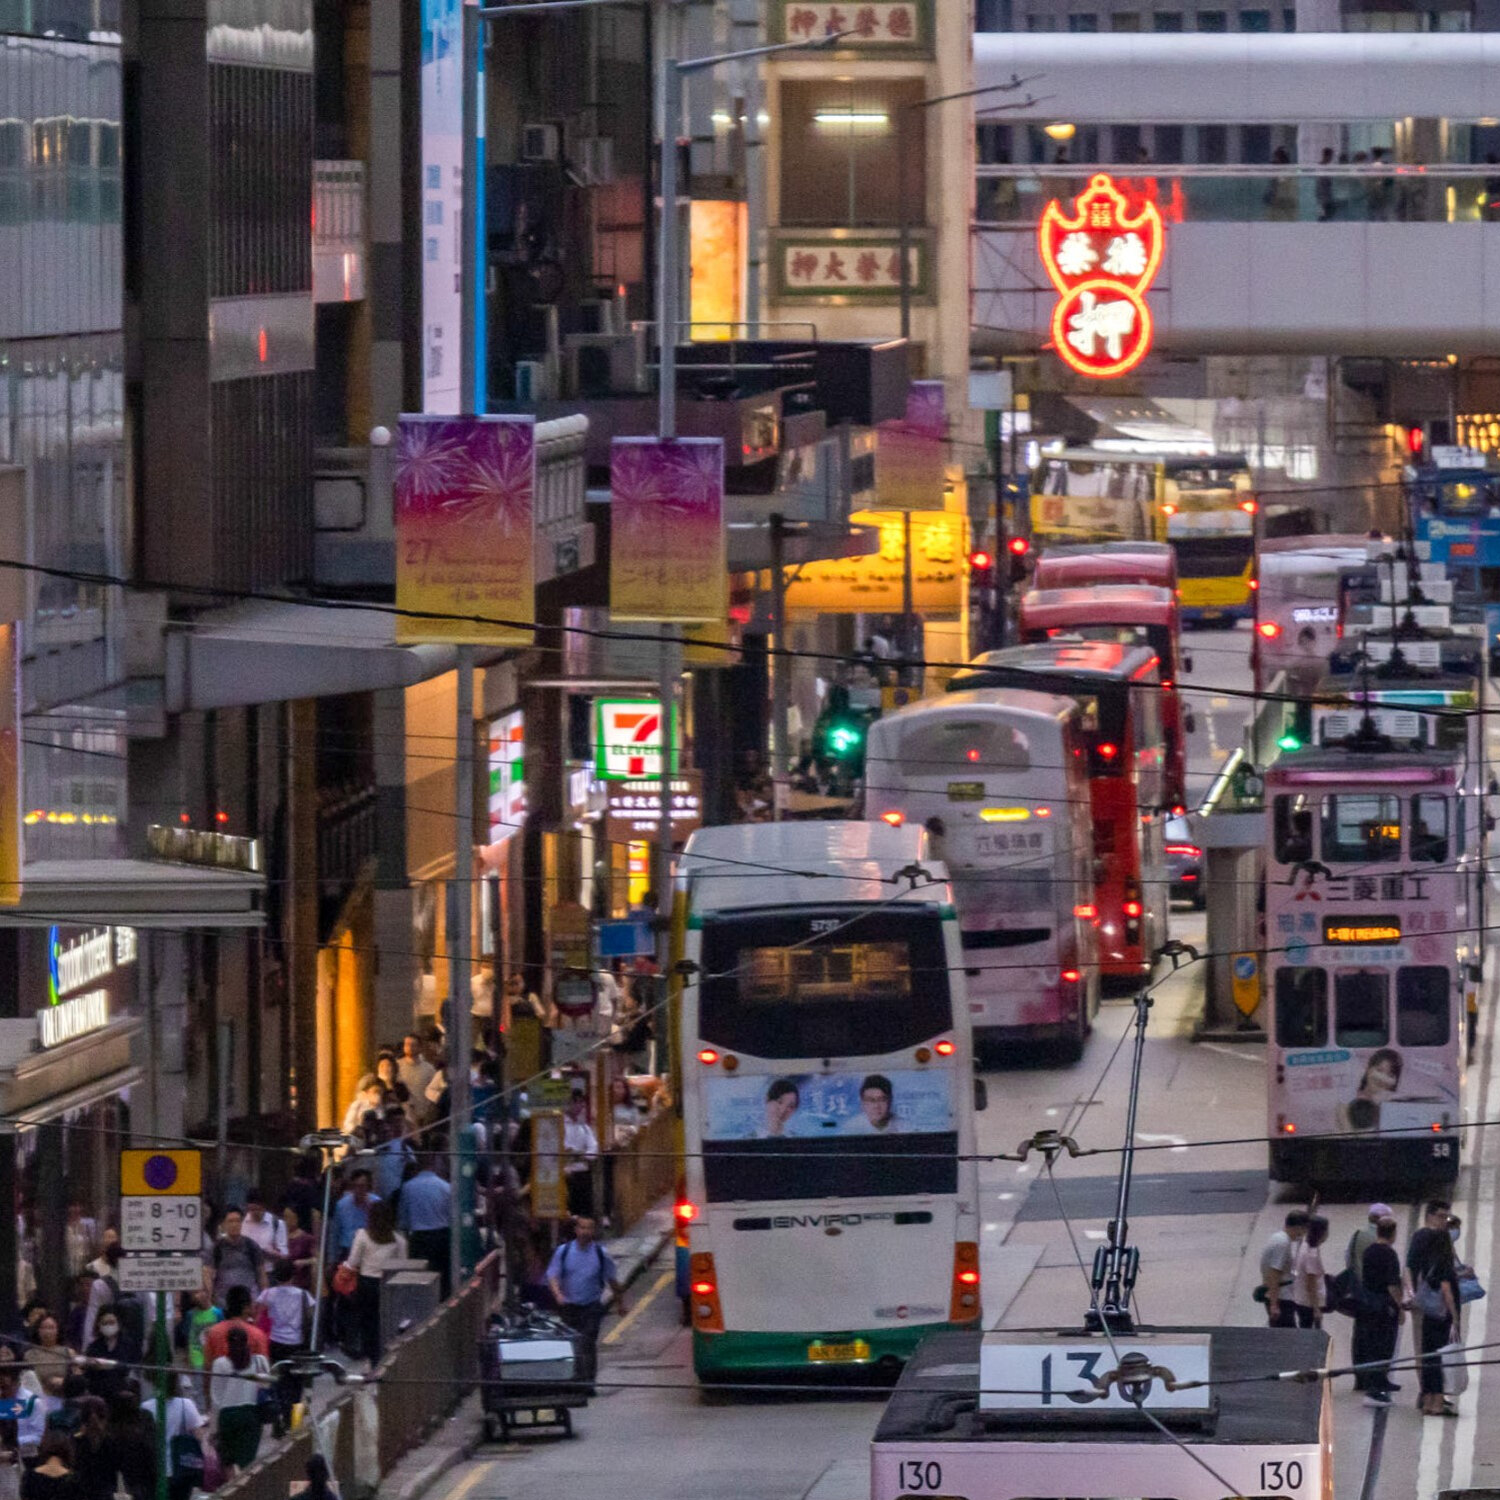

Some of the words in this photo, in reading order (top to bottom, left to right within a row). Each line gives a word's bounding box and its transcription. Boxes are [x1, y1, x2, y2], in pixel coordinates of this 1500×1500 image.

[1326, 876, 1430, 901] 三菱重工
[899, 1461, 942, 1490] 130
[1260, 1461, 1303, 1490] 130
